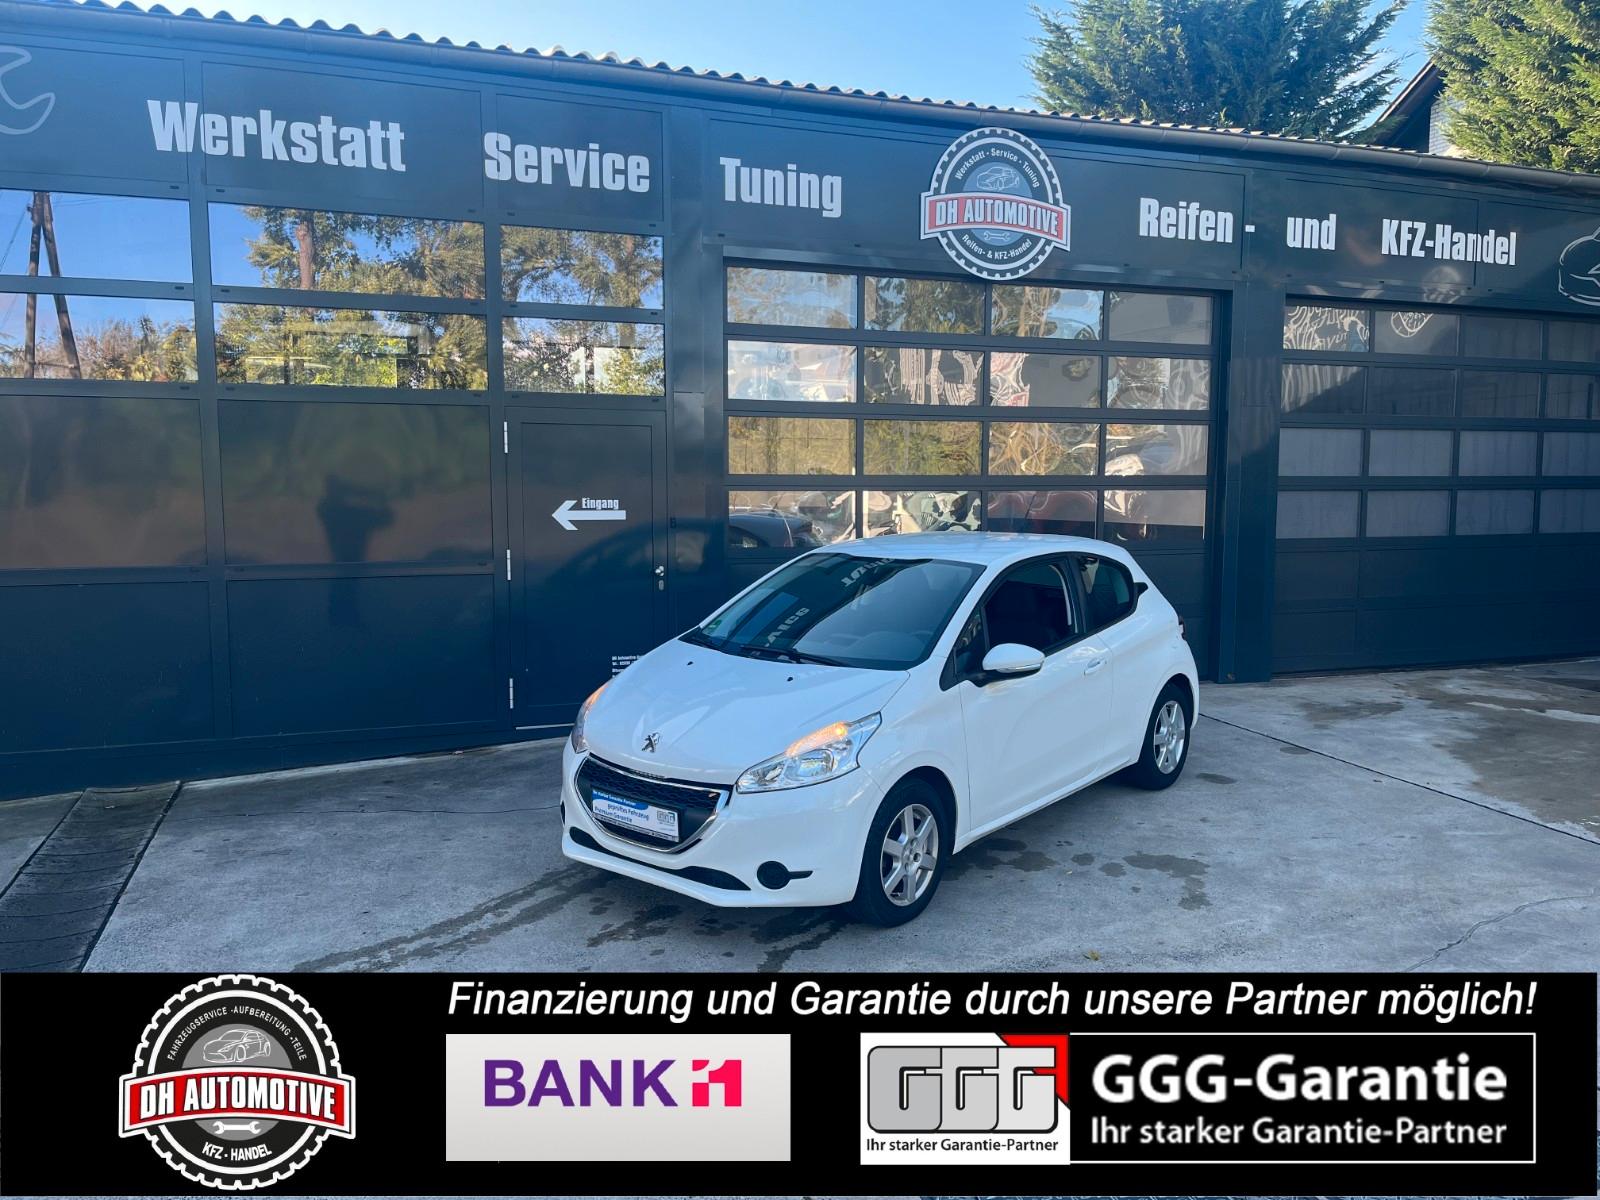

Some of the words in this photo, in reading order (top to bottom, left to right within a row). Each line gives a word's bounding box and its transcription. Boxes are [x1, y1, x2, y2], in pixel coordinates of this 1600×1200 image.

[147, 99, 406, 172] Werkstatt
[483, 132, 650, 193] Service
[955, 150, 985, 180] Werkstatt
[991, 147, 1018, 162] Service
[1022, 161, 1040, 188] Tuning
[720, 156, 842, 218] Tuning
[936, 199, 958, 226] DH
[963, 198, 1058, 236] AUTOMOTIVE
[1286, 213, 1337, 251] und
[1381, 218, 1517, 266] KFZ-Handel
[582, 497, 619, 510] Eingang
